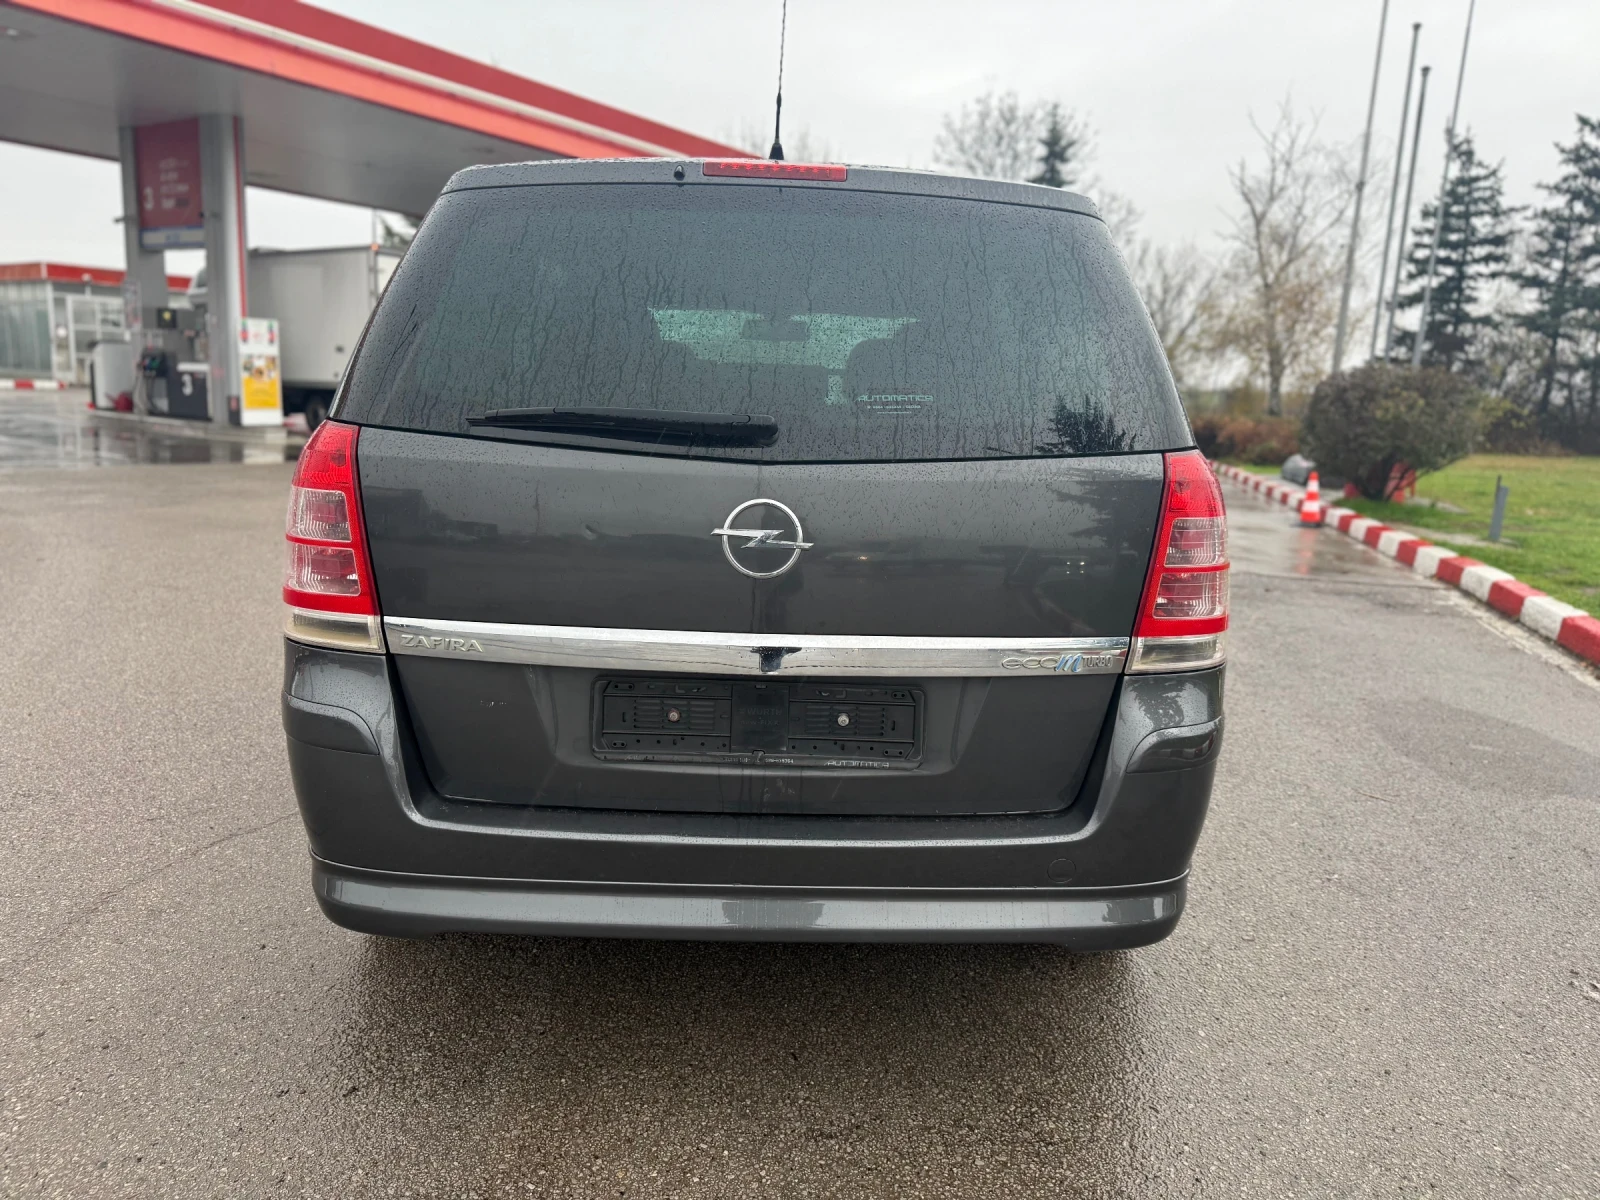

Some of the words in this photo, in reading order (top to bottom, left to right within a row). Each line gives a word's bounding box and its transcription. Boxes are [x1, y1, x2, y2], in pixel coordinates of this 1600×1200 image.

[181, 373, 193, 396] 3
[400, 634, 485, 653] ZAFIRA
[1082, 655, 1113, 668] TURBO
